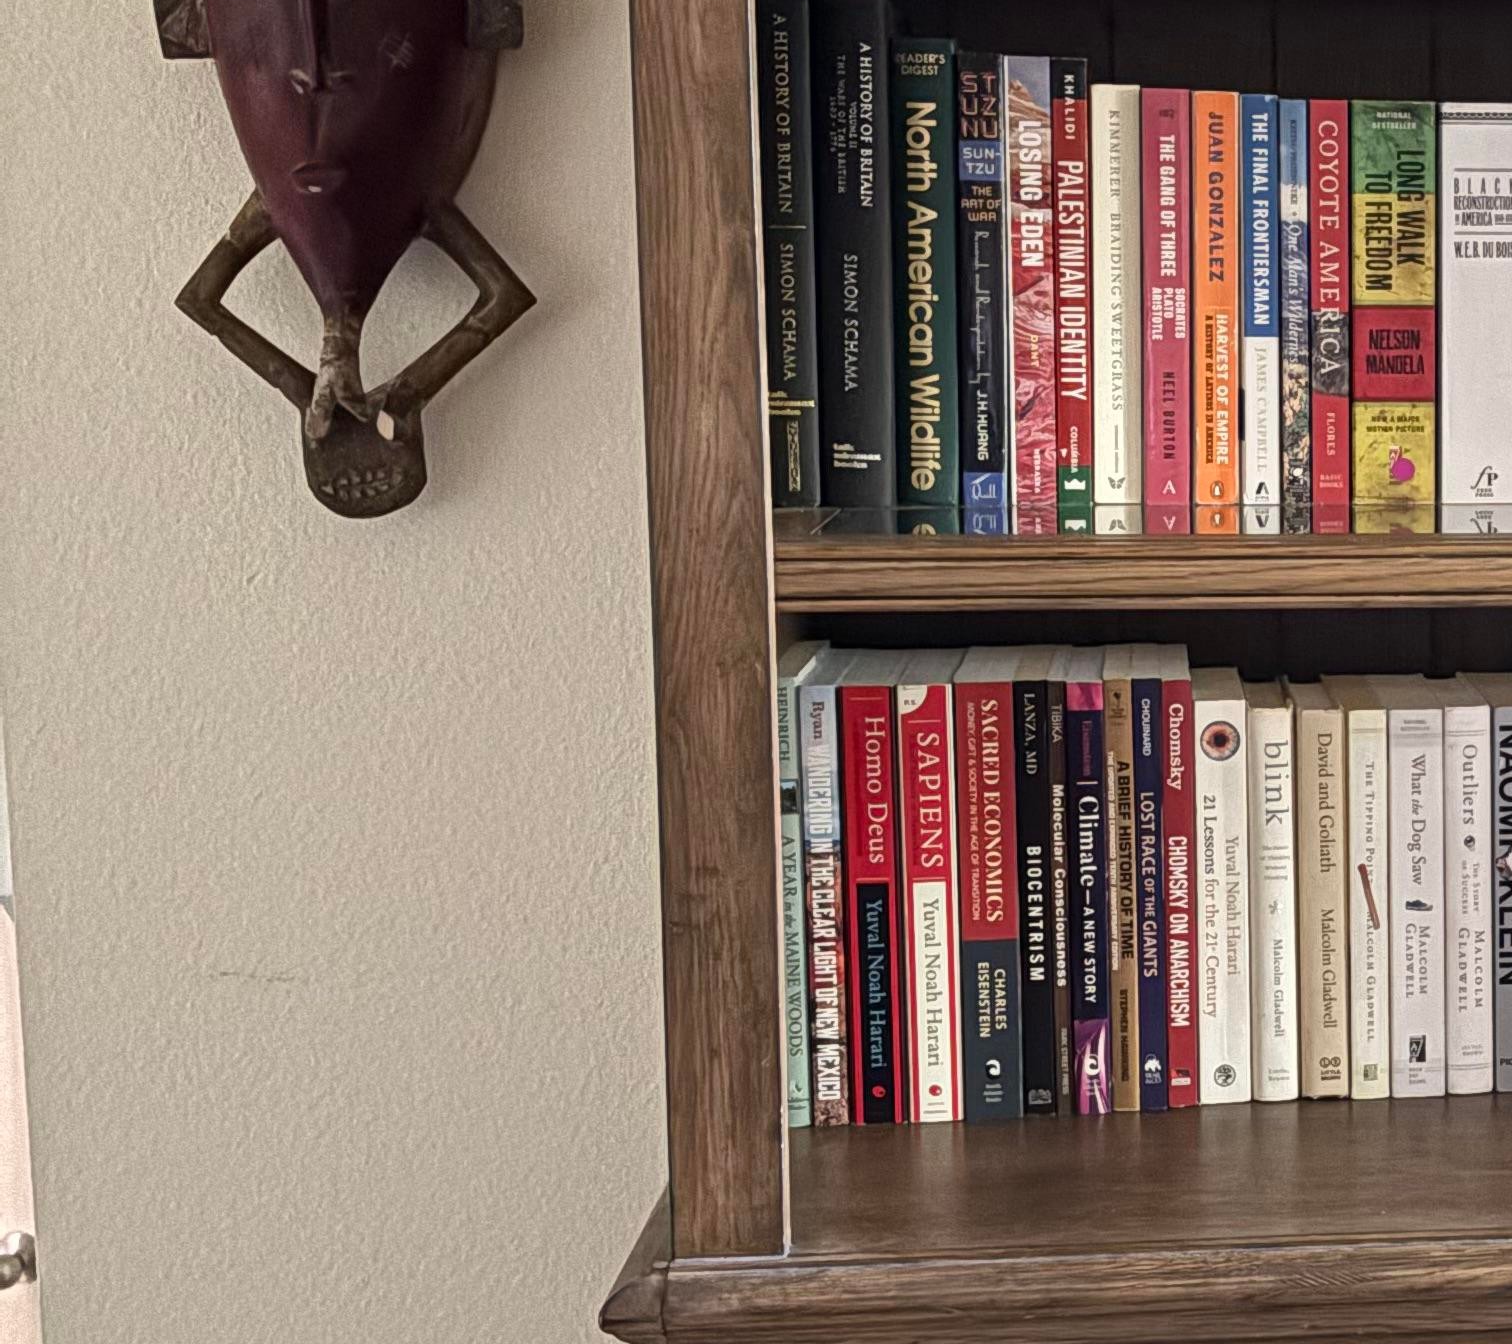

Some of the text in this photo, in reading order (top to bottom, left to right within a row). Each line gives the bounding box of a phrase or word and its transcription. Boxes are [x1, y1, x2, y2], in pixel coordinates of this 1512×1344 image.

[1018, 120, 1043, 267] LOSING EDEN
[1109, 110, 1120, 208] KIMMERER
[1208, 112, 1224, 282] JUAN GONZALEZ
[1395, 150, 1425, 266] LONG WALK
[906, 101, 939, 490] North American Wildlife
[1058, 161, 1087, 400] PALESTINIAN IDENTITY
[1317, 121, 1340, 374] COYOTE AMERICA
[1364, 170, 1393, 291] TO FREEDOM
[780, 243, 795, 381] SIMON SCHAMA
[1110, 214, 1123, 411] BRAIDING SWEETGRASS
[1151, 288, 1163, 340] ARISTOTLE
[1164, 288, 1173, 319] PLATO
[1175, 288, 1185, 339] SOCRATES
[1366, 355, 1424, 374] MANDELA
[1370, 330, 1420, 349] NELSON
[864, 717, 889, 864] Homo Deus
[1141, 698, 1151, 756] CHOUINARD
[1166, 704, 1184, 790] Chomsky
[1264, 740, 1290, 826] blink
[1462, 744, 1478, 825] Outliers
[918, 732, 943, 868] SAPIENS
[981, 699, 1004, 922] SACRED ECONOMICS
[1026, 845, 1045, 982] BIOCENTRISM
[1052, 785, 1066, 987] Molecular Consciousness
[1168, 836, 1190, 1028] CHOMSKY ON ANARCHISM
[922, 898, 942, 1067] Yuval Noah Harari
[1320, 908, 1337, 1028] Malcolm Gladwell
